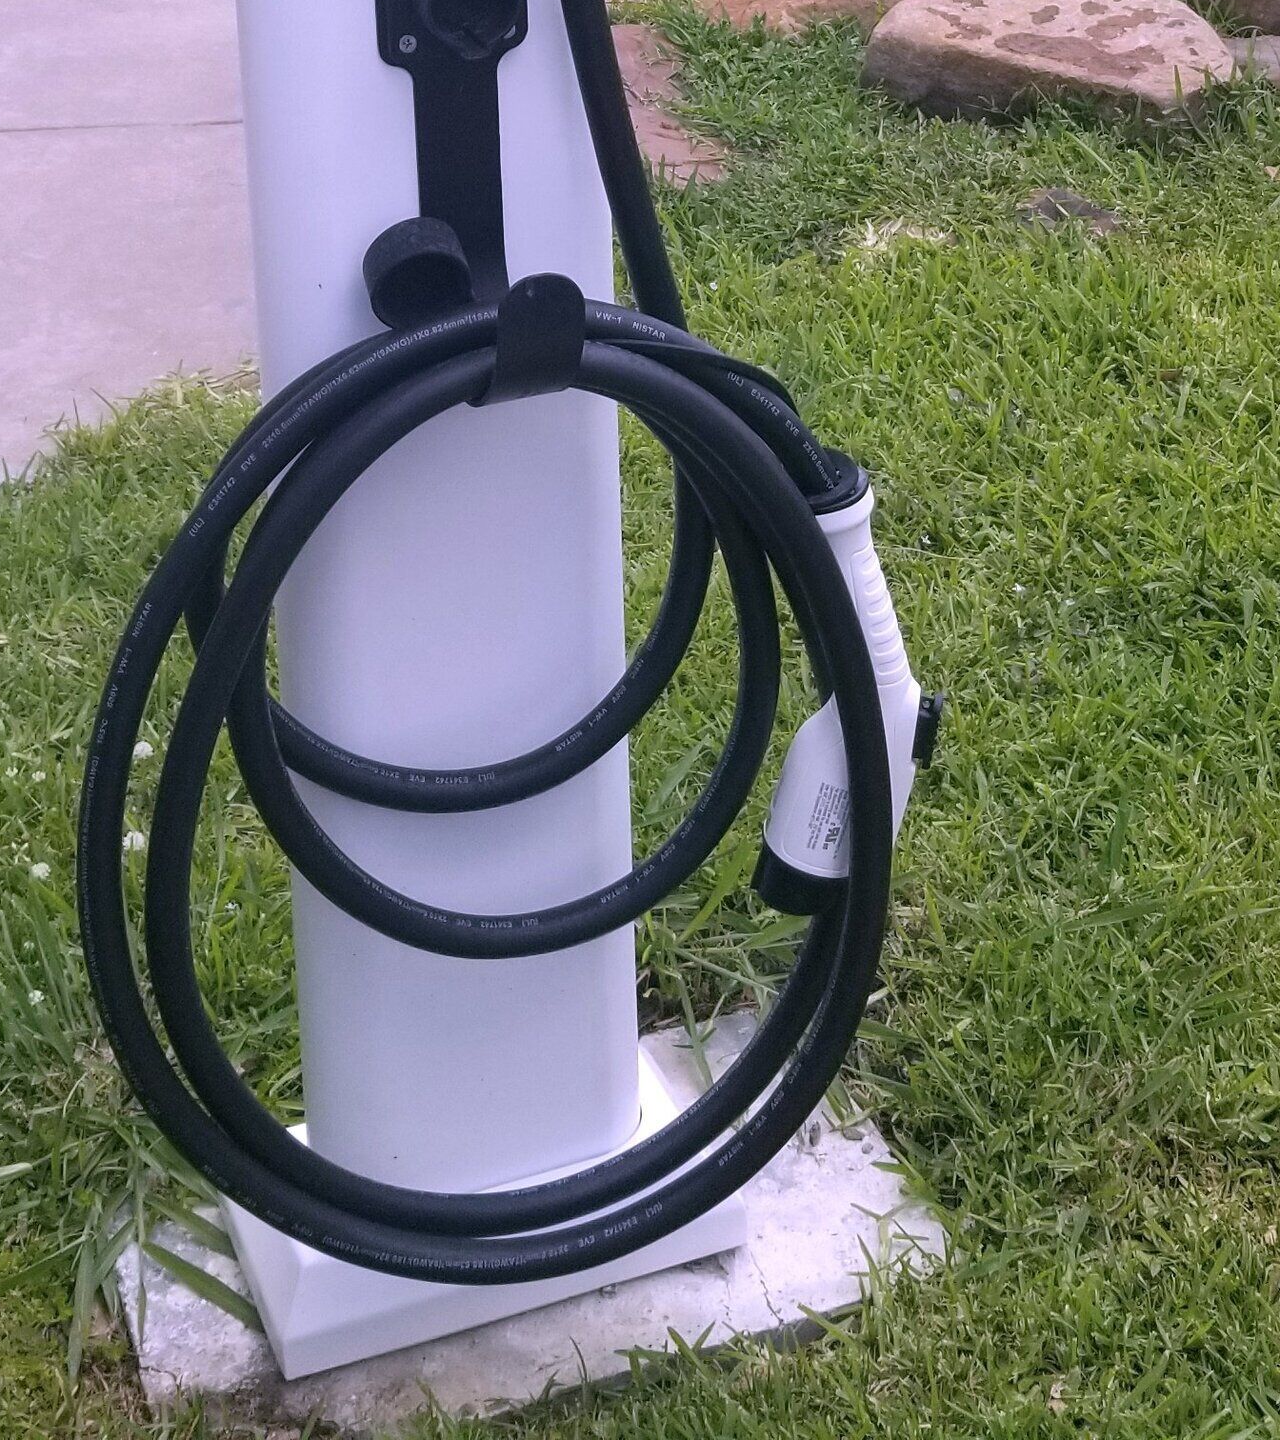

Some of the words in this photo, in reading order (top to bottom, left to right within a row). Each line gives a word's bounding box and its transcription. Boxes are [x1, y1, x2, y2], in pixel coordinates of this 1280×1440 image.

[595, 311, 622, 325] VW-1
[632, 321, 666, 342] NISTAR
[727, 371, 745, 388] (UL)
[784, 419, 800, 437] EVE
[117, 647, 132, 674] VW-1
[132, 601, 152, 638] NISTAR
[188, 517, 206, 537] (UL)
[588, 708, 608, 728] VW-1
[554, 730, 583, 752] NISTAR
[635, 864, 655, 883] VW-1
[600, 885, 630, 904] NISTAR
[577, 1235, 596, 1248] EVE
